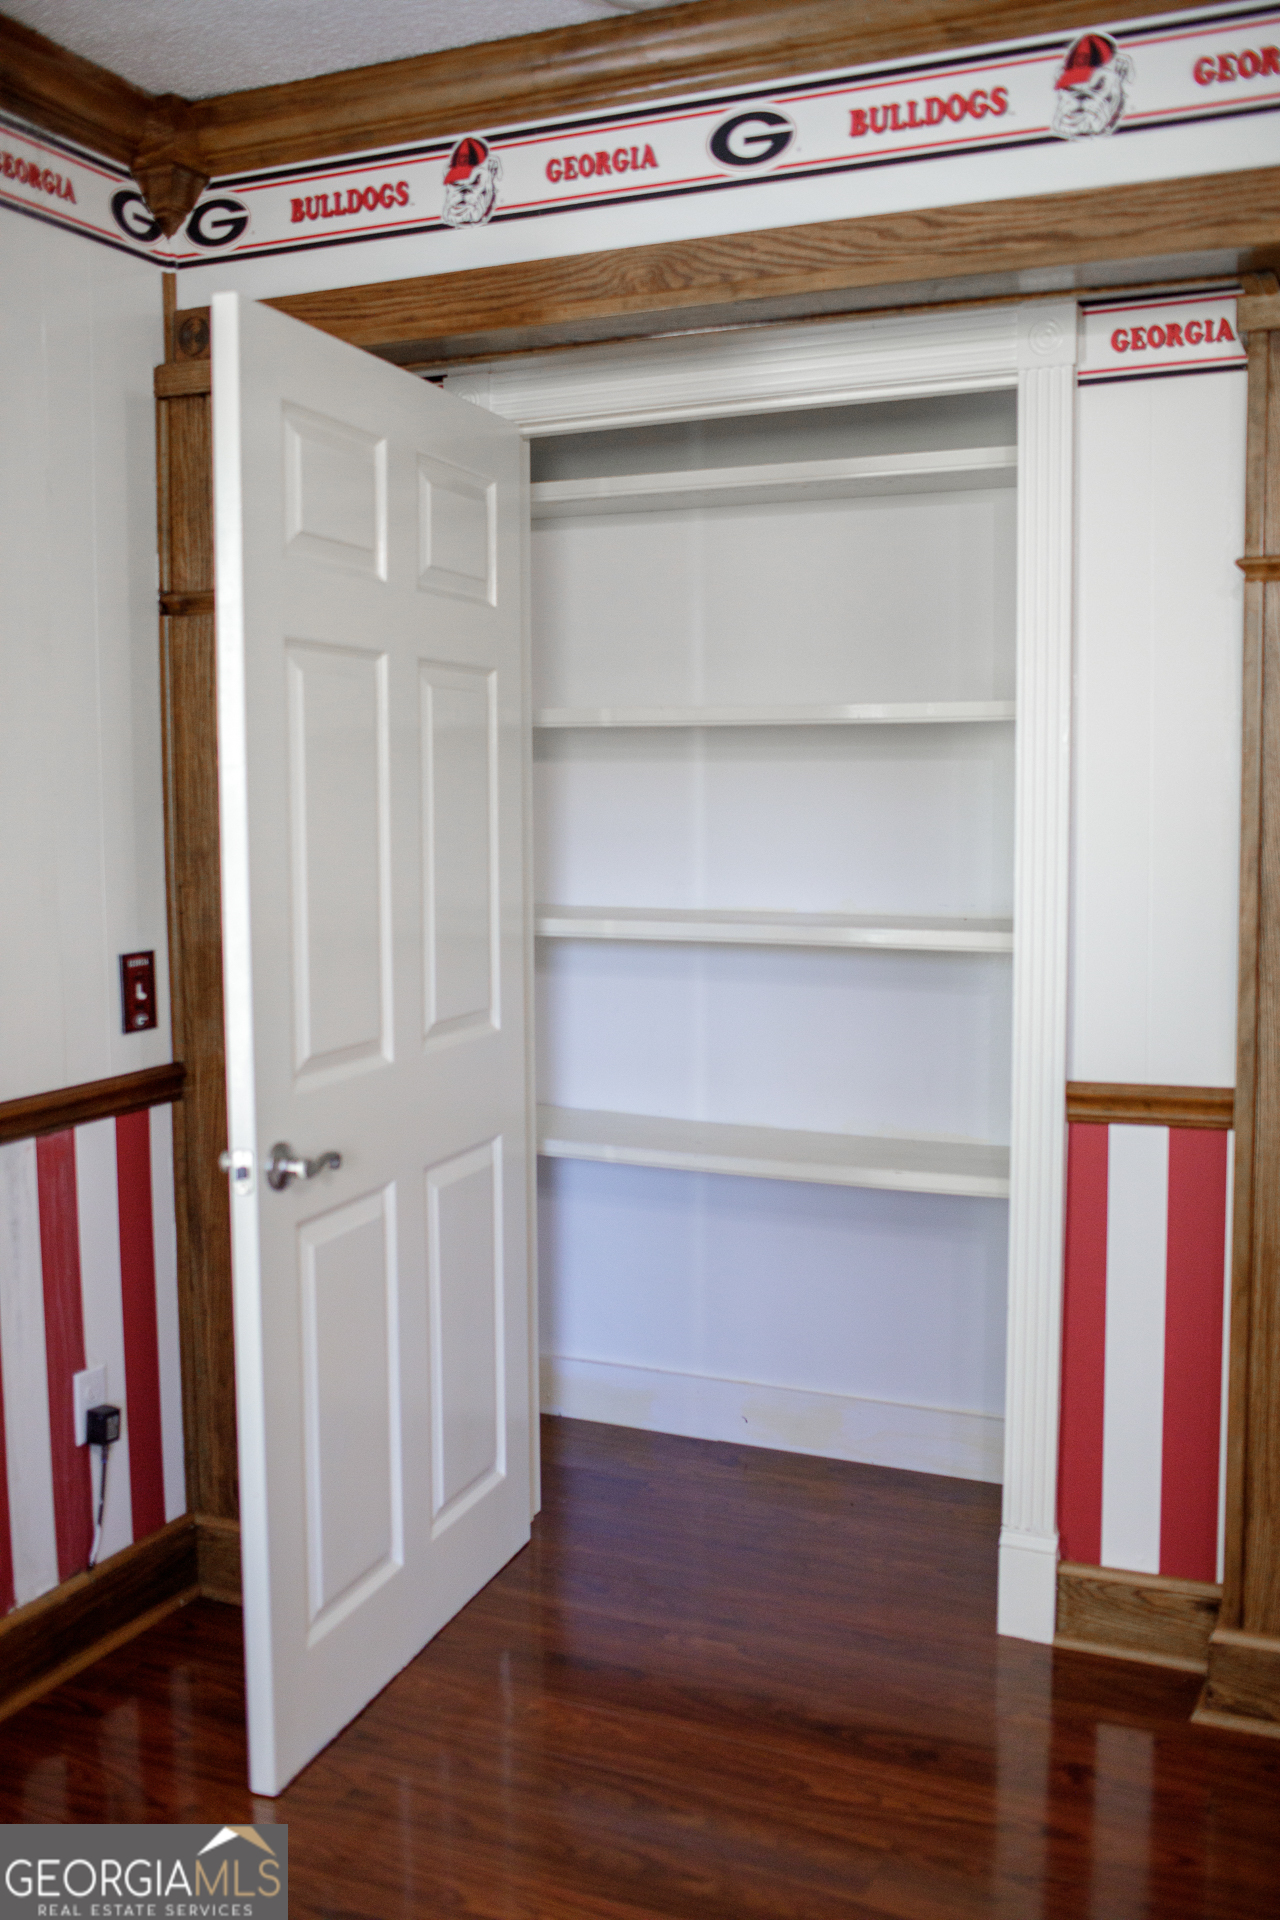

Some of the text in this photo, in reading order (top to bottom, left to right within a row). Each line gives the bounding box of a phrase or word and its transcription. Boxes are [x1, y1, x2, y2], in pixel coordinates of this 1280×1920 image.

[0, 151, 77, 204] EORGIA
[186, 199, 248, 247] G
[290, 181, 409, 223] BULLDOGS
[545, 144, 658, 184] GEORGIA
[711, 111, 794, 166] G
[848, 86, 1008, 138] BULLDOGS
[1110, 318, 1235, 353] GEORGIA
